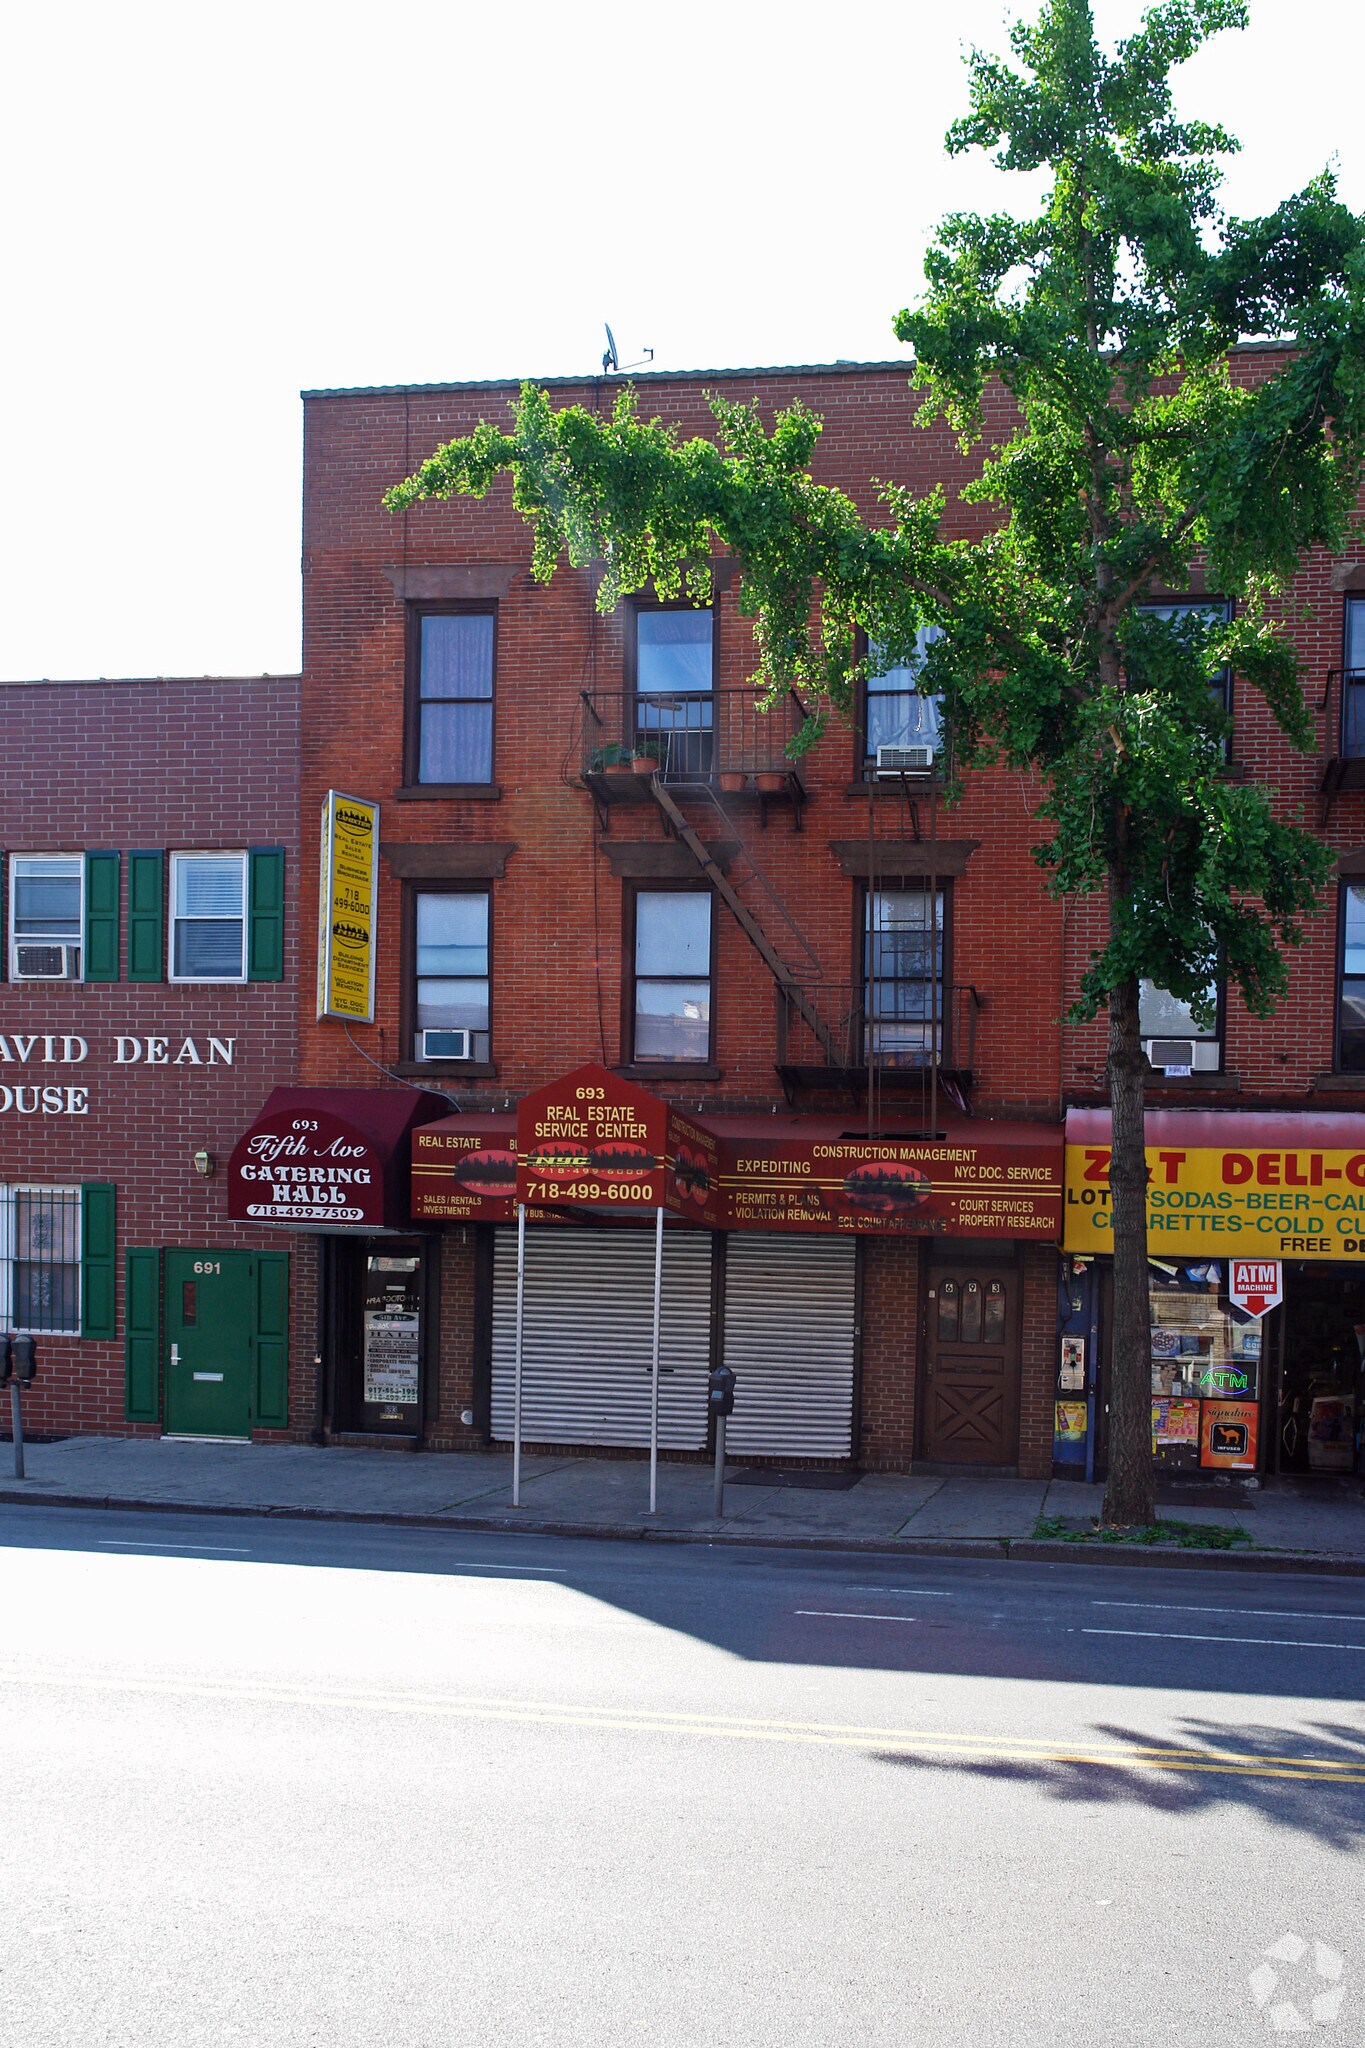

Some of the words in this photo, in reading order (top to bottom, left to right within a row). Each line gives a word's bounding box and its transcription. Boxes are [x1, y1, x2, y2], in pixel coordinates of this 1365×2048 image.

[345, 844, 361, 854] SALES
[350, 838, 372, 849] ESTATE
[344, 888, 359, 900] 718
[334, 896, 370, 915] 499-6000
[334, 976, 364, 988] VIOLATION
[334, 997, 347, 1005] NYC
[113, 1037, 236, 1065] DEAN
[576, 1087, 605, 1100] 693
[547, 1106, 580, 1121] REAL
[588, 1107, 635, 1121] ESTATE
[292, 1119, 318, 1131] 693
[535, 1122, 588, 1137] SERVICE
[596, 1123, 647, 1138] CENTER
[247, 1135, 310, 1162] Fifth
[314, 1136, 367, 1158] Ave
[419, 1136, 444, 1148] REAL
[446, 1137, 481, 1149] ESTATE
[813, 1145, 896, 1160] CONSTRUCTION
[900, 1148, 977, 1162] MANAGEMENT
[535, 1157, 588, 1165] NYC
[736, 1160, 811, 1173] EXPEDITING
[1083, 1150, 1186, 1183] ZT
[240, 1165, 371, 1184] CATERING
[955, 1166, 976, 1178] NYC
[979, 1167, 1004, 1179] DOC.
[1007, 1167, 1052, 1180] SERVICE
[272, 1184, 346, 1204] HALL
[526, 1183, 653, 1200] 718-499-6000
[423, 1195, 446, 1204] SALES
[451, 1196, 481, 1205] RENTALS
[736, 1193, 776, 1205] PERMITS
[779, 1195, 786, 1205] &
[788, 1194, 820, 1206] PLANS
[959, 1199, 989, 1211] COURT
[991, 1200, 1034, 1213] SERVICES
[253, 1206, 359, 1219] 718-499-7509
[423, 1206, 470, 1215] INVESTMENTS
[513, 1210, 529, 1218] NW
[736, 1208, 785, 1220] VIOLATION
[787, 1209, 832, 1221] REMOVAL
[857, 1217, 887, 1229] COURT
[959, 1215, 1005, 1227] PROPERTY
[1007, 1216, 1054, 1229] RESEARCH
[1280, 1237, 1331, 1252] FREE
[194, 1261, 220, 1274] 691
[1237, 1265, 1274, 1282] ATM
[1200, 1372, 1248, 1388] ATM
[368, 1387, 417, 1395] 917-553-195
[1207, 1407, 1254, 1419] signature
